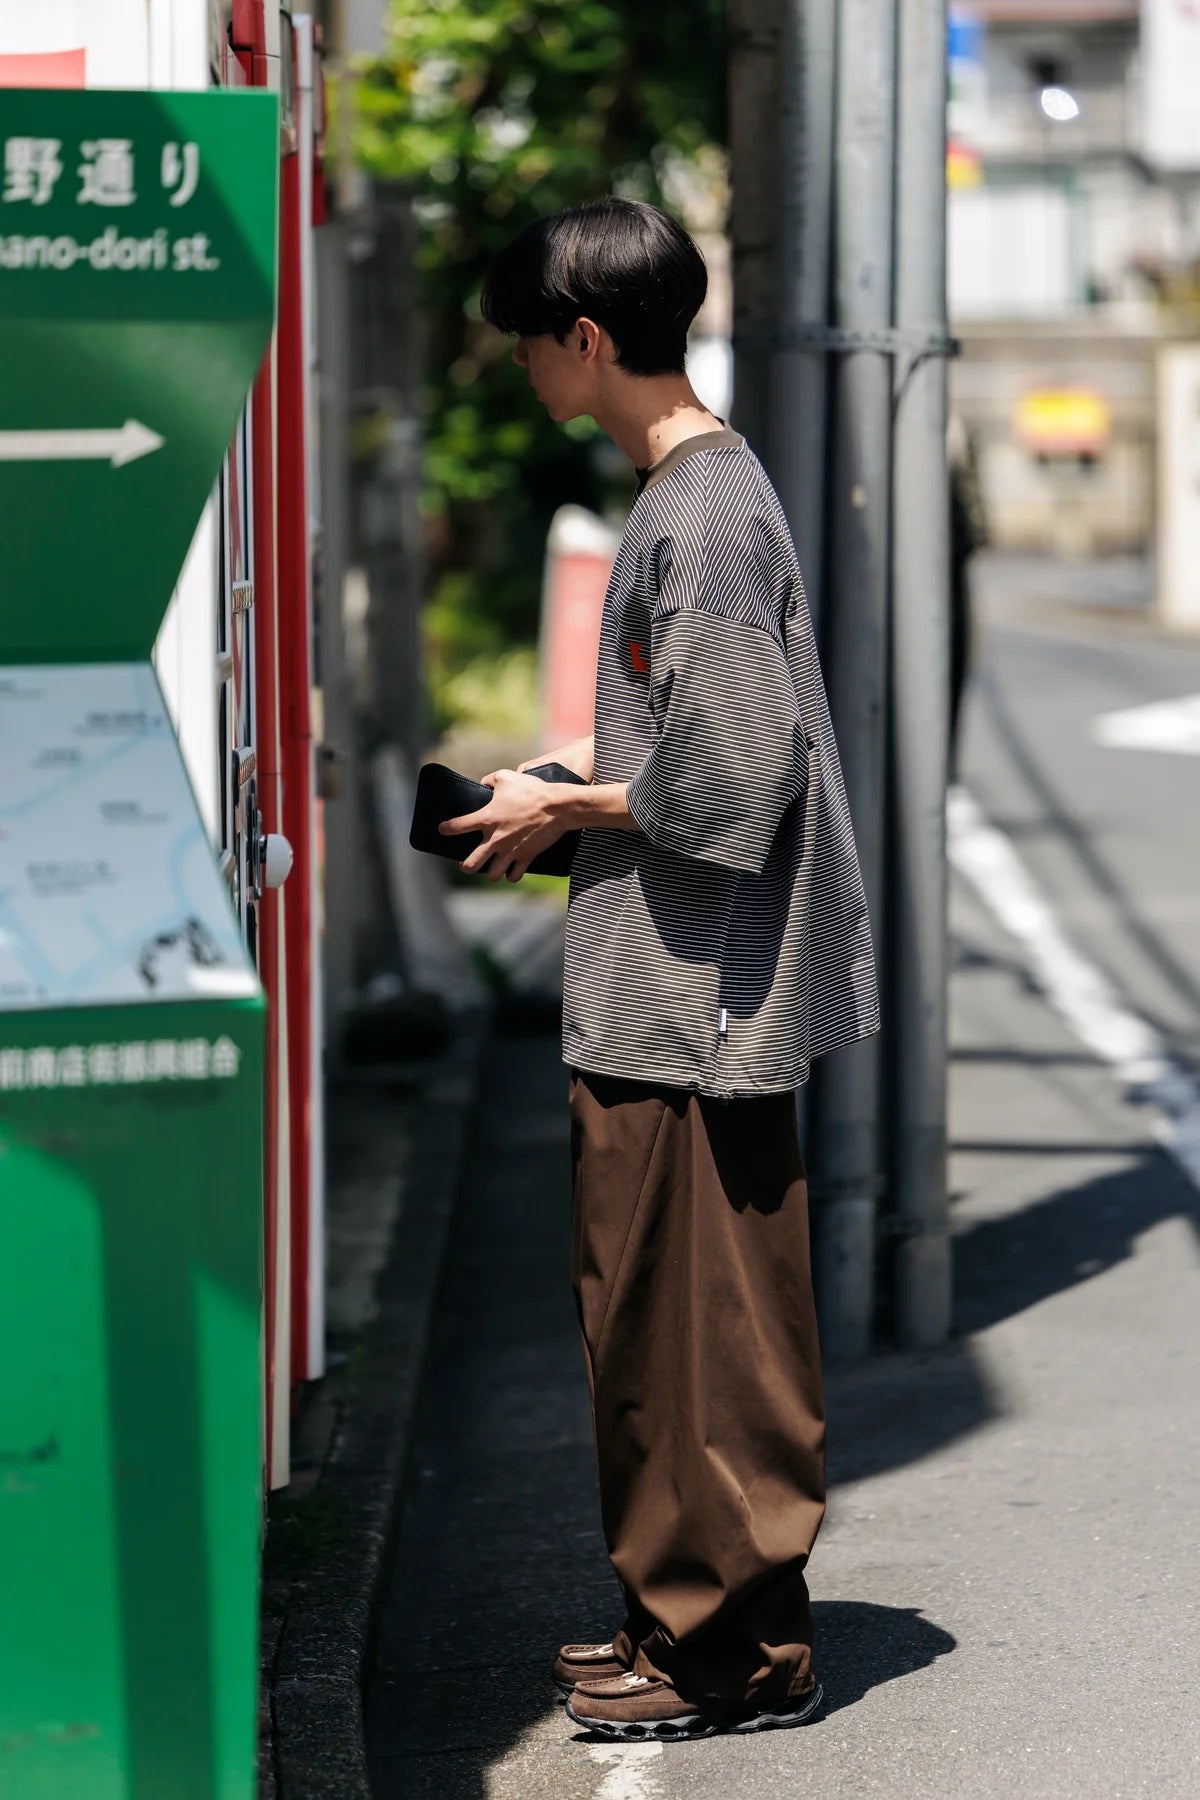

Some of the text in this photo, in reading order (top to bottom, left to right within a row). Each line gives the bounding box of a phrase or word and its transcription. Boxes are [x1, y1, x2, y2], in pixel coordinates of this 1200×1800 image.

[2, 137, 200, 206] 野通り
[0, 226, 220, 271] ano-dori st.
